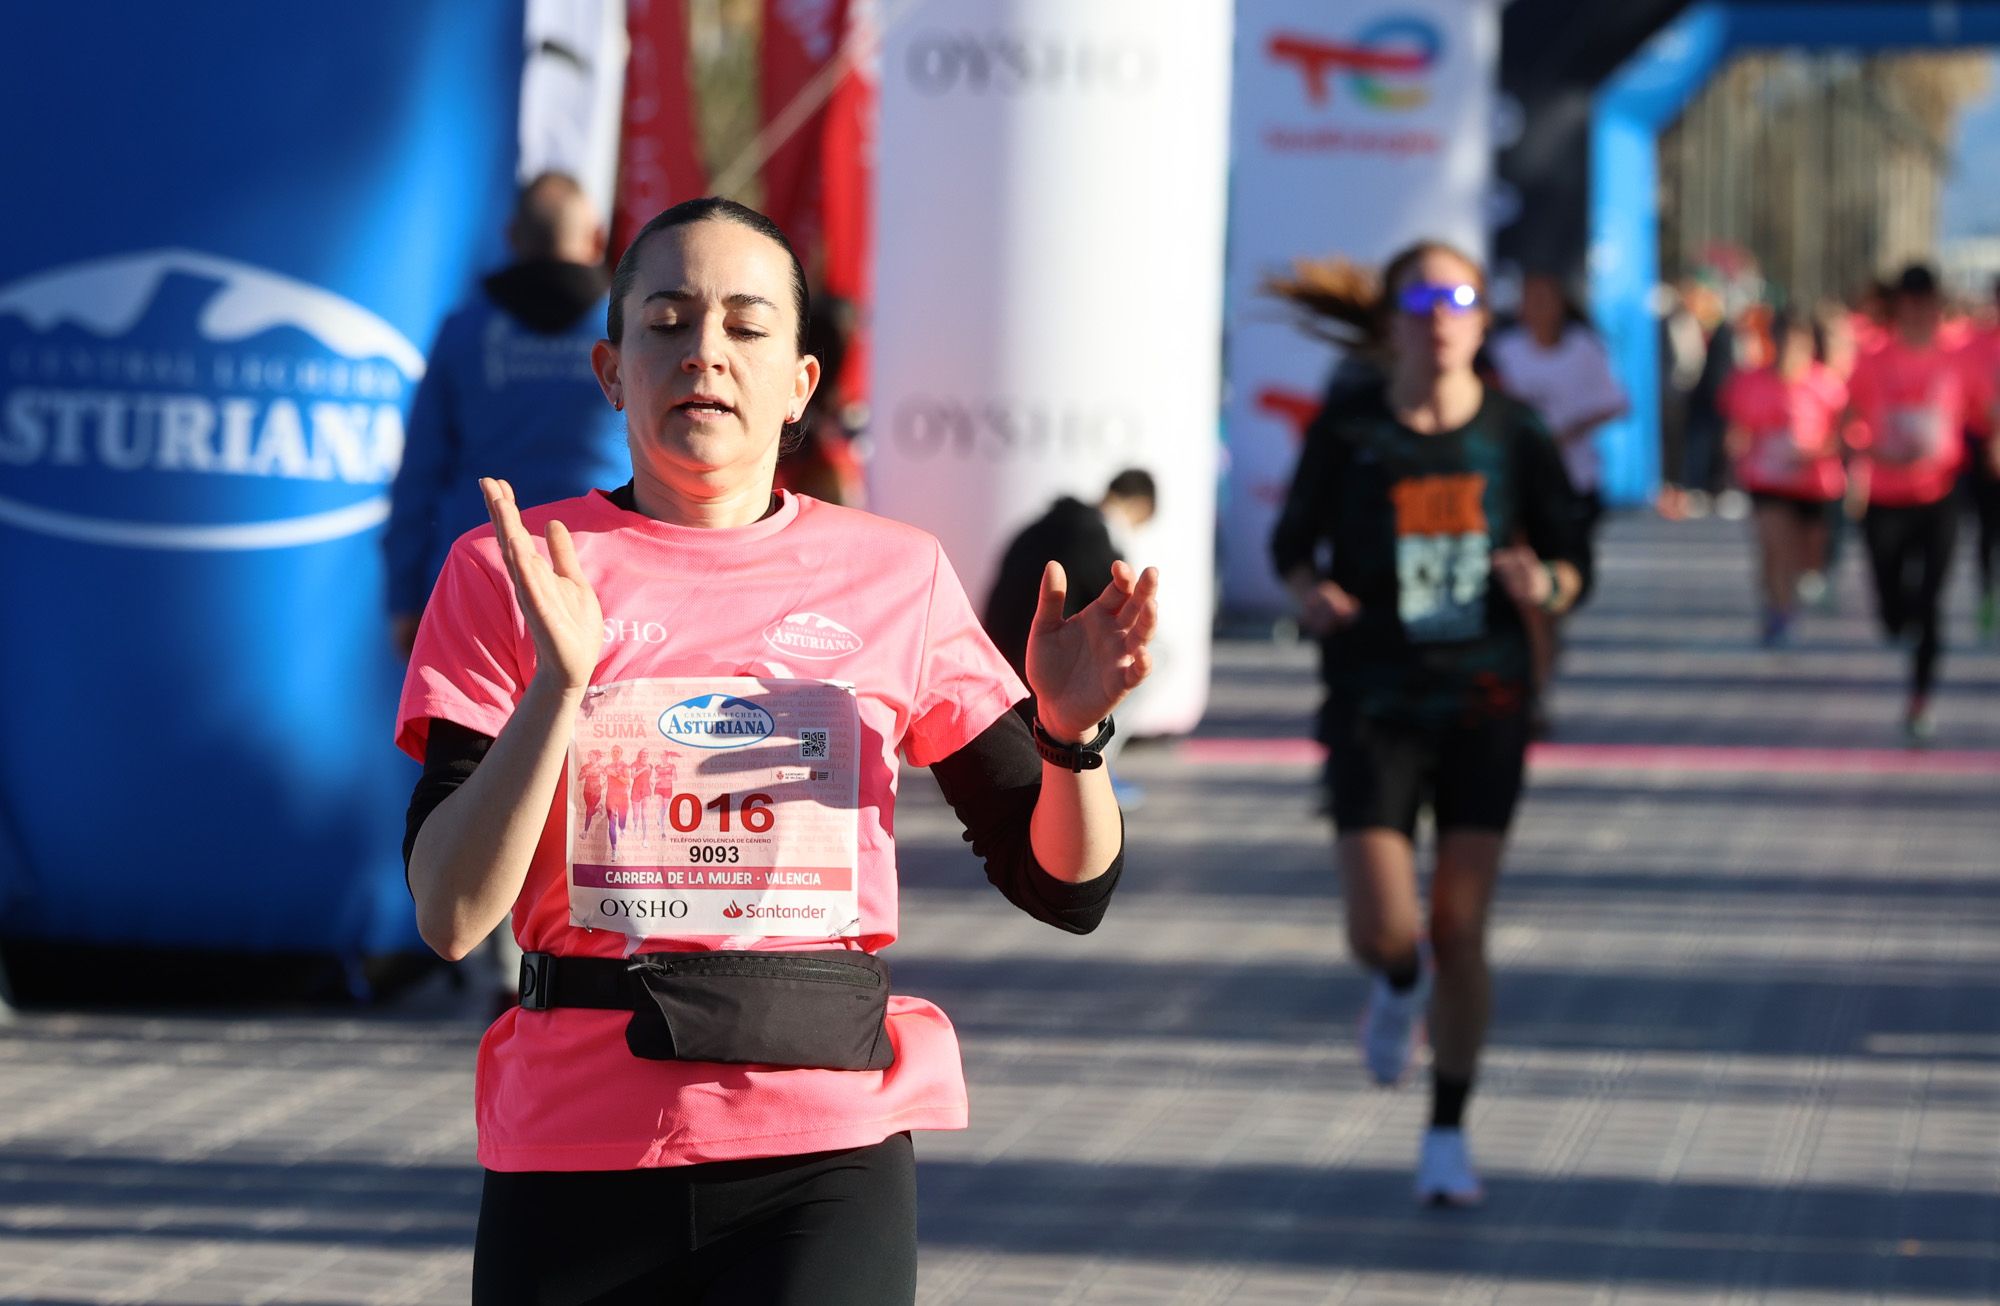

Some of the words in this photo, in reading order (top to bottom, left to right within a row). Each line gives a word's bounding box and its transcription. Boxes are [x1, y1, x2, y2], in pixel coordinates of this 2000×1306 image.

[771, 628, 855, 650] ASTURIANA
[606, 713, 647, 723] DORSAL
[666, 713, 768, 736] ASTURIANA
[592, 723, 647, 739] SUMA
[669, 792, 775, 834] 016
[689, 845, 740, 864] 9093
[604, 871, 664, 885] CARRERA
[667, 871, 684, 885] DE
[688, 871, 704, 885] LA
[708, 871, 753, 885] MUJER
[764, 872, 822, 885] VALENCIA
[600, 898, 689, 919] OYSHO
[745, 903, 827, 919] Santander
